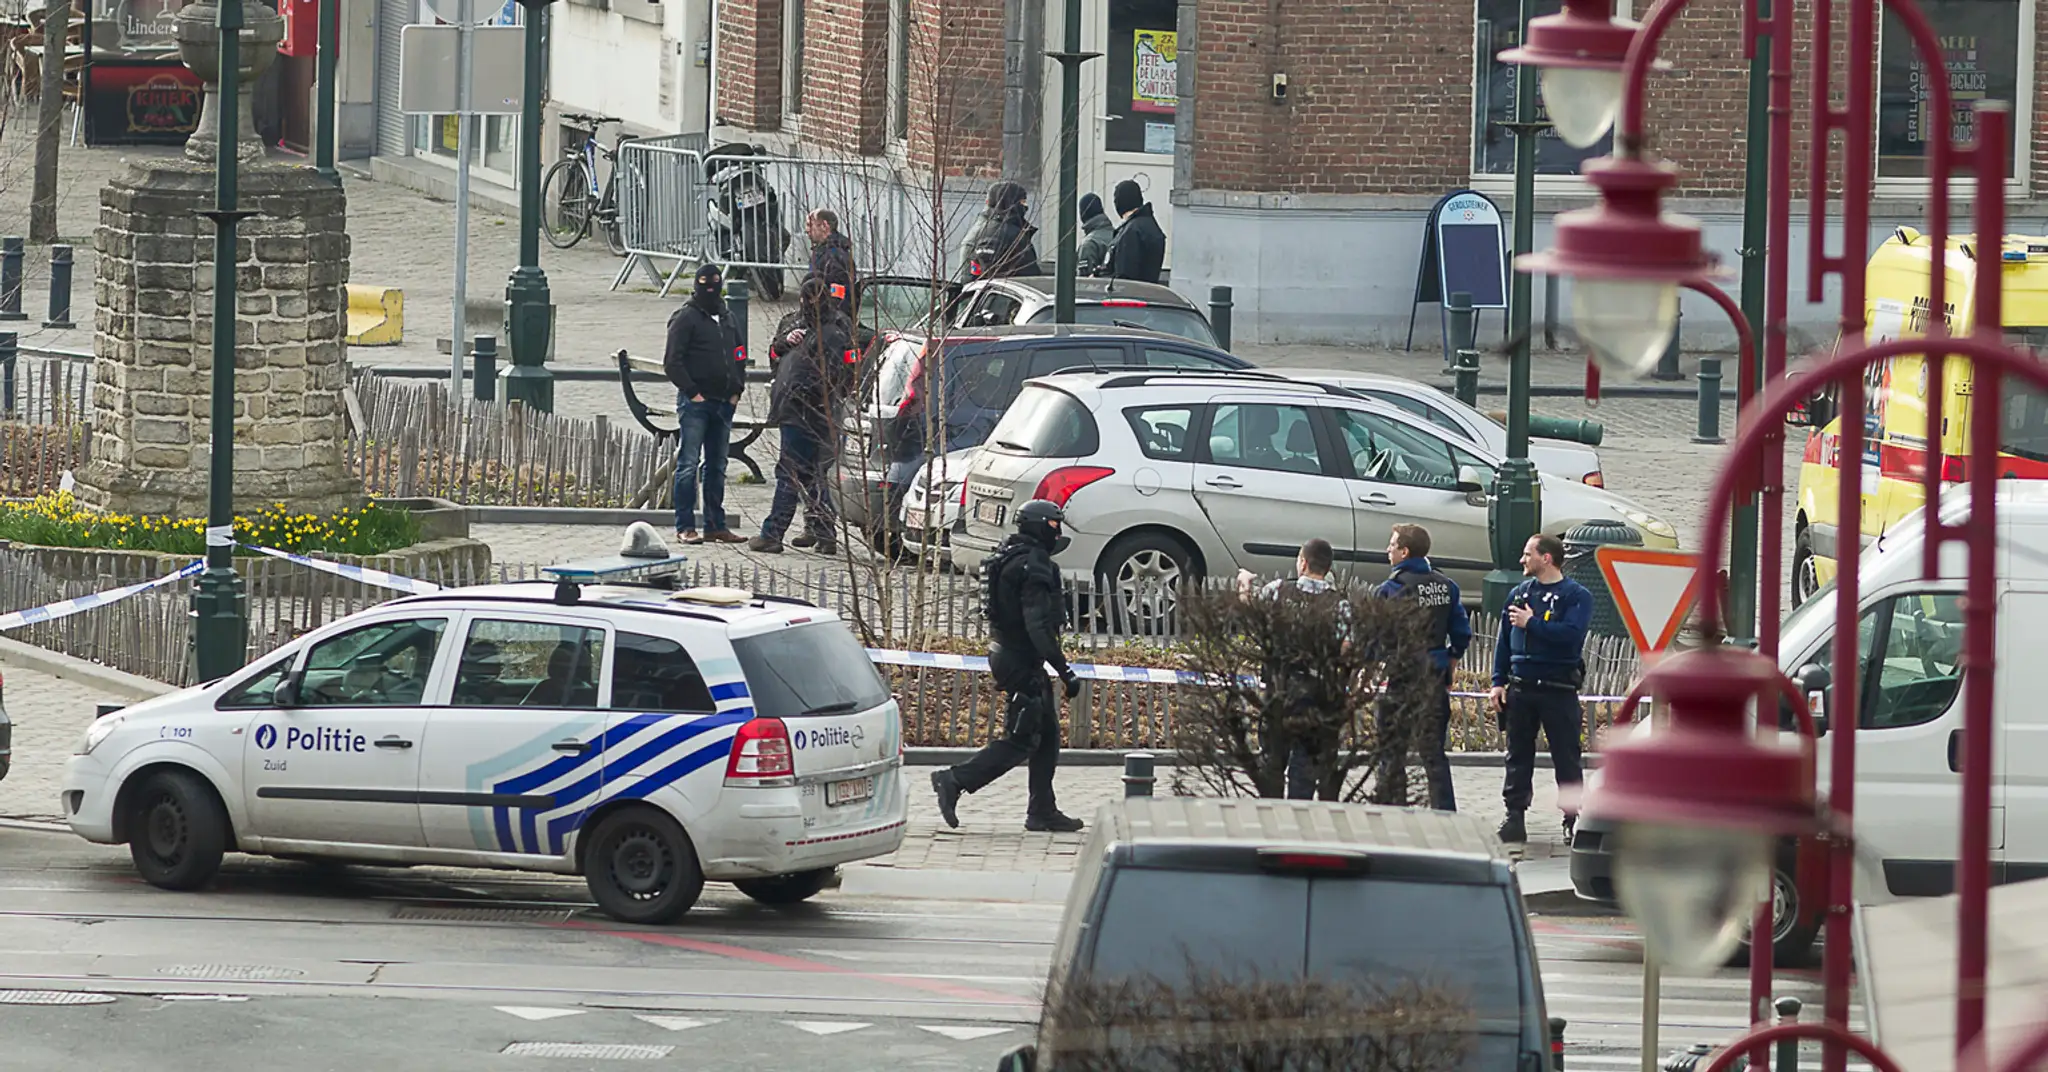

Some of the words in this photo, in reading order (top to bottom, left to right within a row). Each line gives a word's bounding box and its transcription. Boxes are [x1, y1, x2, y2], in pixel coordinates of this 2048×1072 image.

[1160, 69, 1177, 82] PLAC
[136, 92, 192, 107] KRIEK
[1418, 582, 1448, 595] Police
[1419, 594, 1451, 607] Politie
[173, 728, 193, 738] 101
[810, 727, 850, 748] Politie
[286, 727, 366, 753] Politie
[263, 760, 287, 771] Zuid
